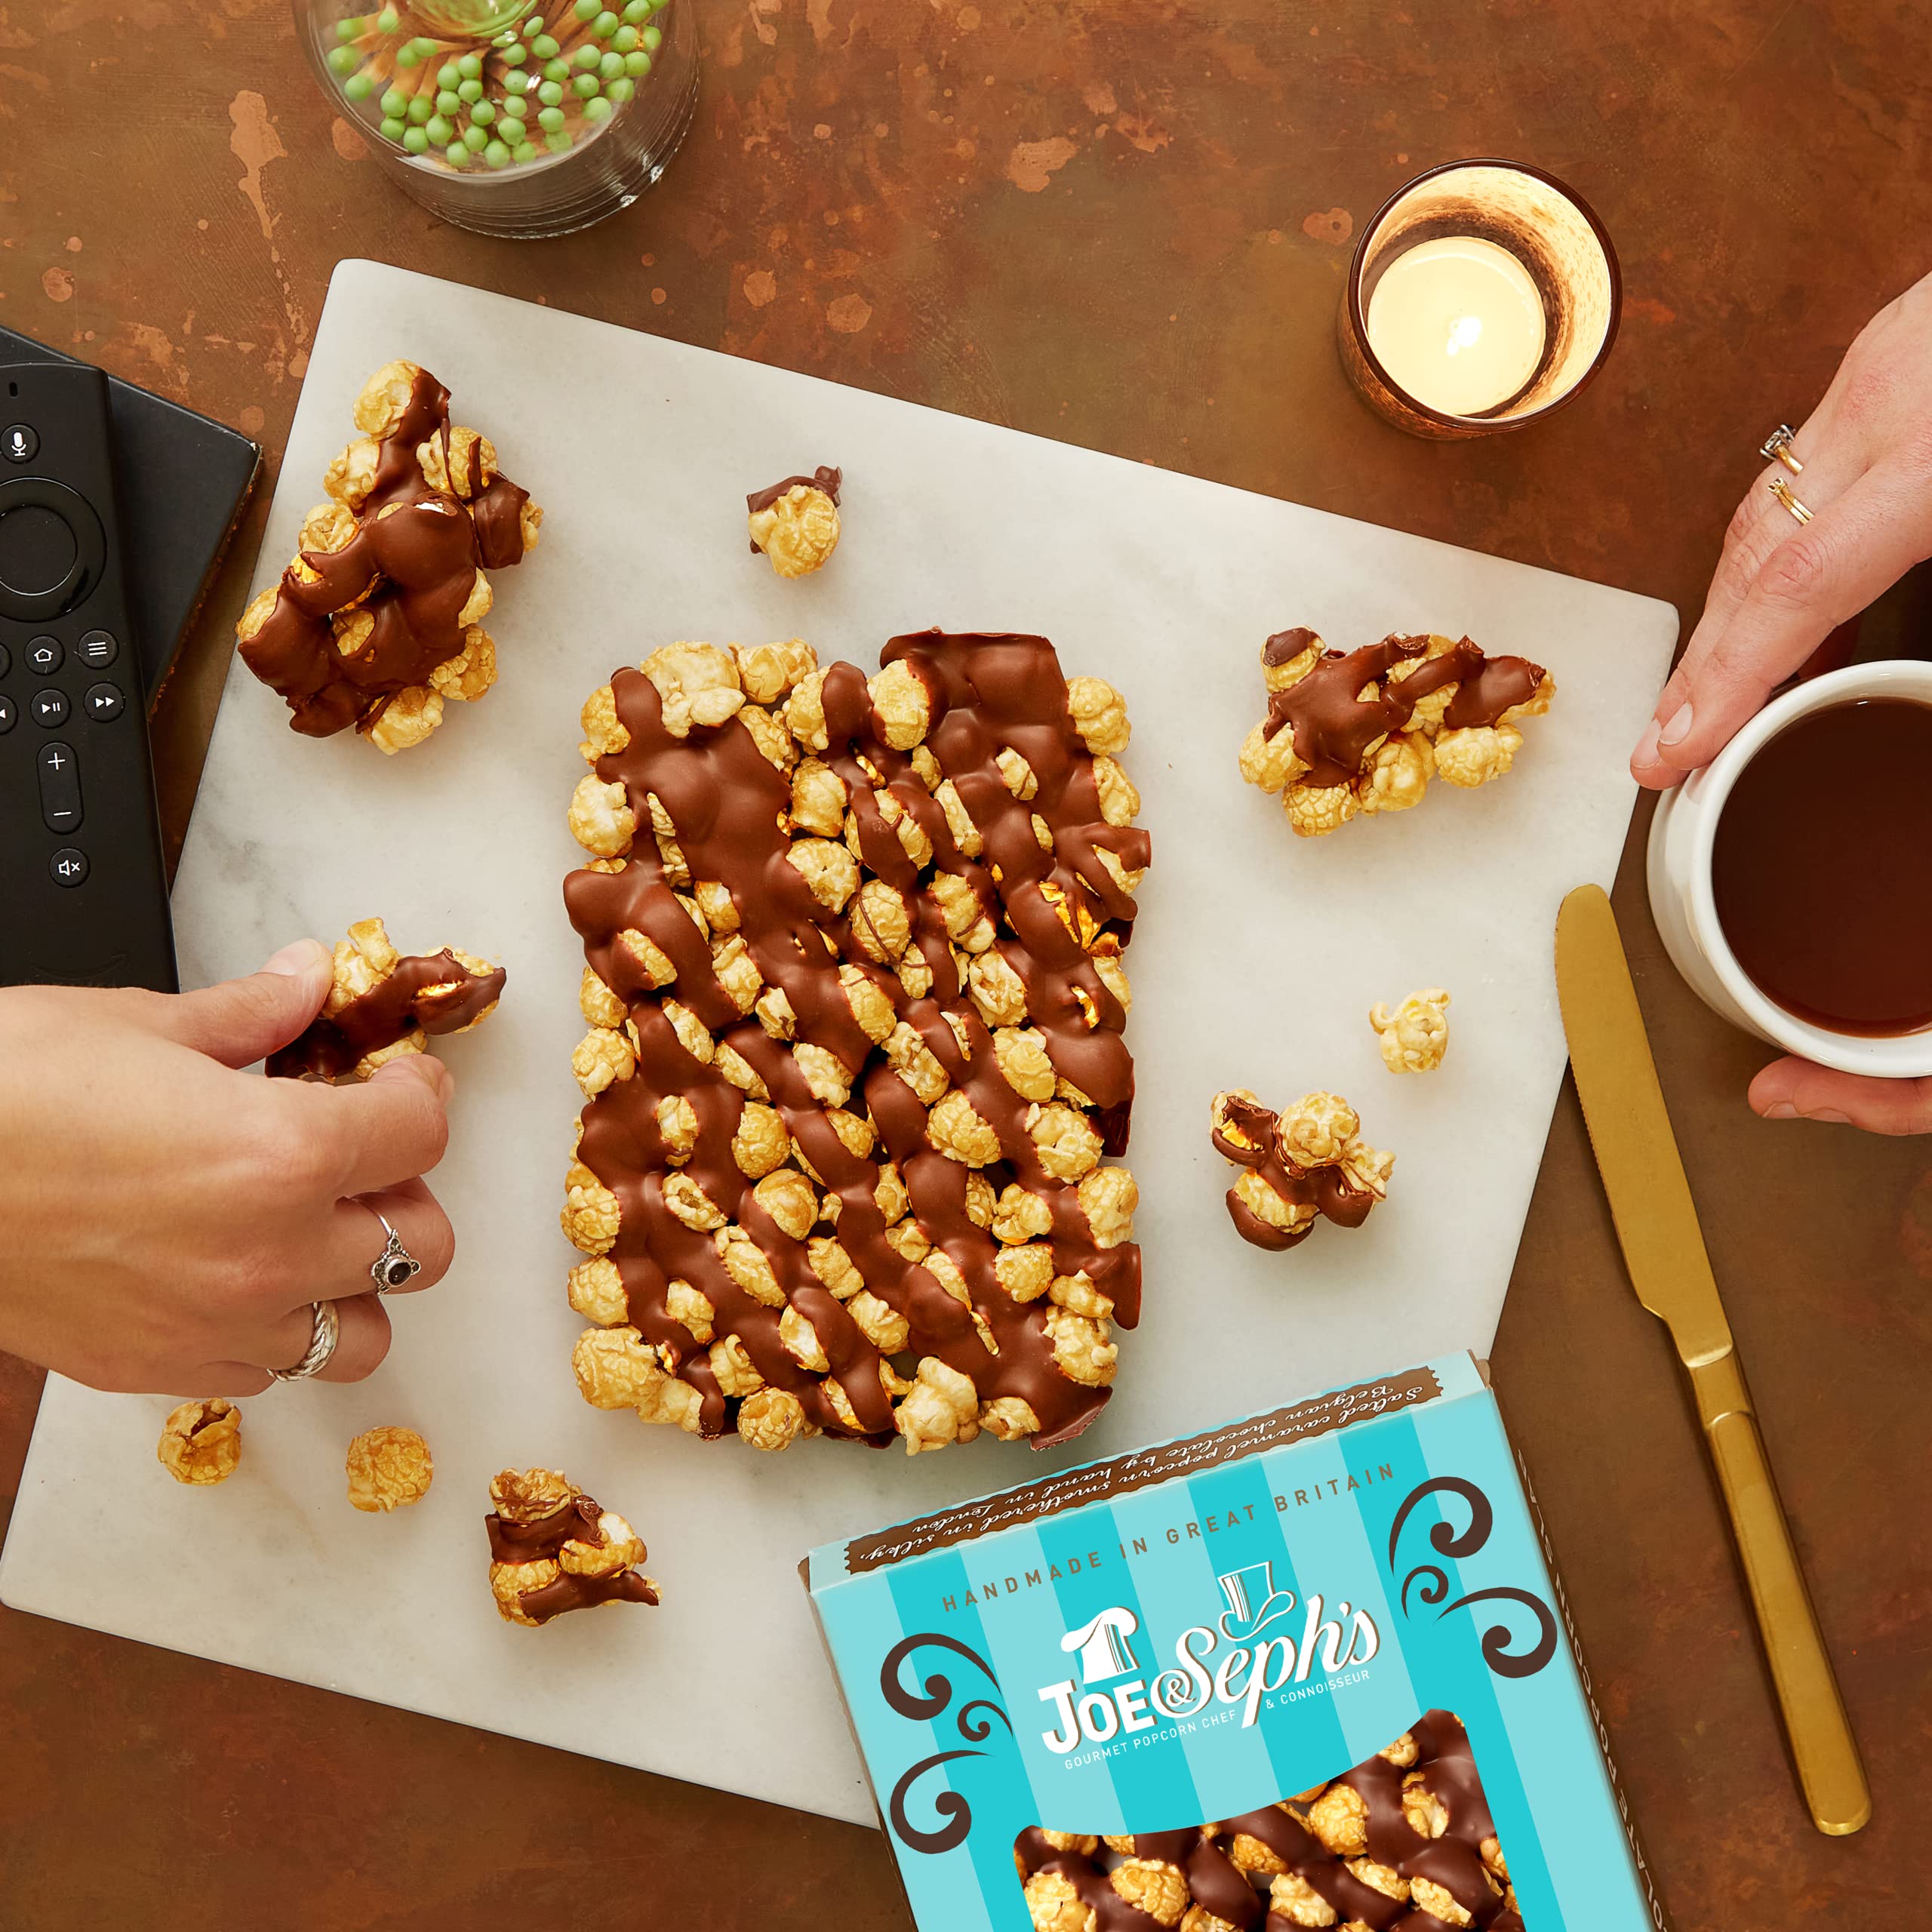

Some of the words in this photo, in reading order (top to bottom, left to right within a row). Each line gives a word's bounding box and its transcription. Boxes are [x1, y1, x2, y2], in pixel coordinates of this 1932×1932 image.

[1284, 1386, 1393, 1420] Belgian
[1337, 1386, 1423, 1423] Salted
[1165, 1420, 1276, 1457] chocolate
[1223, 1416, 1331, 1459] caramel
[1118, 1447, 1218, 1483] popcorn
[1121, 1454, 1156, 1469] by
[1004, 1491, 1034, 1505] in
[1041, 1468, 1112, 1499] hand
[912, 1503, 995, 1533] London
[980, 1481, 1111, 1531] smothered
[1518, 1449, 1553, 1564] SLAB
[859, 1534, 935, 1561] silky,
[942, 1552, 1101, 1612] HANDMADE
[1118, 1537, 1148, 1560] IN
[1166, 1504, 1254, 1544] GREAT
[1274, 1463, 1393, 1512] BRITAIN
[943, 1522, 973, 1537] in
[1037, 1679, 1158, 1755] JOE
[1150, 1594, 1380, 1729] Seph's
[1555, 1572, 1617, 1784] POPCORN
[1065, 1743, 1128, 1770] GOURMET
[1133, 1721, 1196, 1749] POPCORN
[1201, 1710, 1235, 1728] CHEF
[1266, 1699, 1275, 1709] &
[1281, 1669, 1370, 1704] CONNOISSEUR
